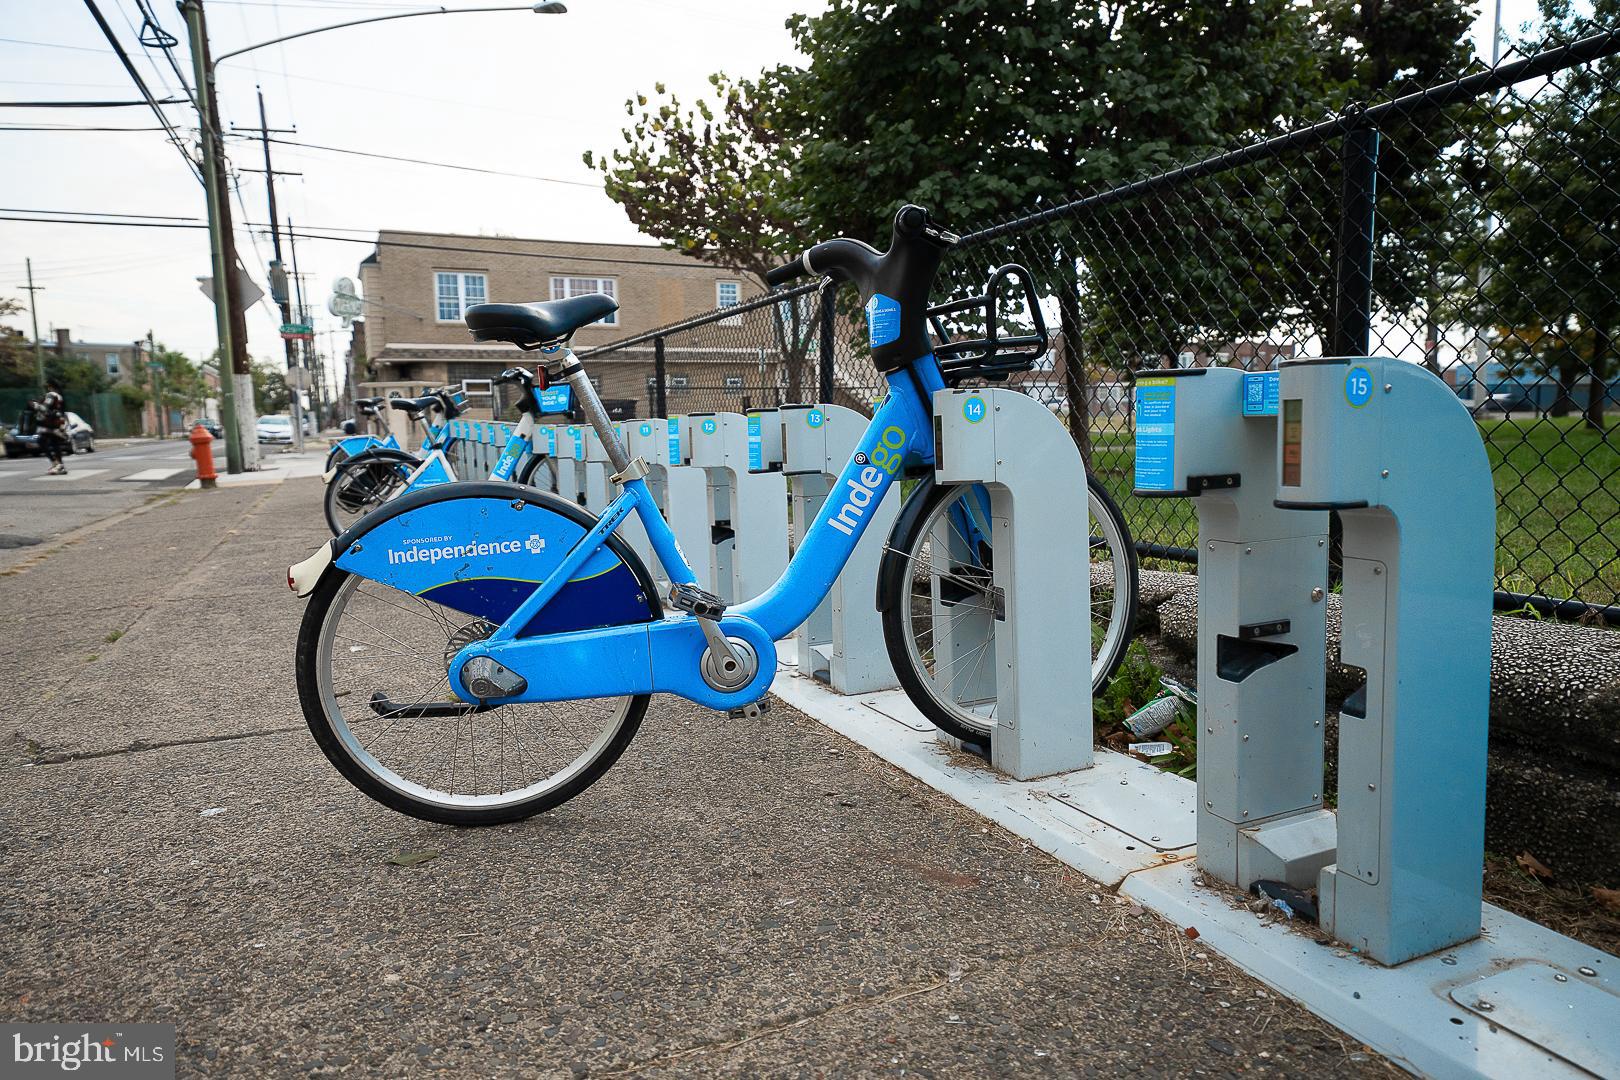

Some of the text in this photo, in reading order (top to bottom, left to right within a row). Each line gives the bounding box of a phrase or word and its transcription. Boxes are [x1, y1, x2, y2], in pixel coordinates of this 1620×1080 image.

[1351, 377, 1368, 396] 15
[967, 403, 981, 416] 14
[810, 413, 821, 424] 13
[704, 422, 714, 432] 12
[827, 425, 906, 536] Indego
[597, 506, 624, 535] TREK
[402, 536, 443, 545] SPONSORED
[388, 540, 522, 565] Independence
